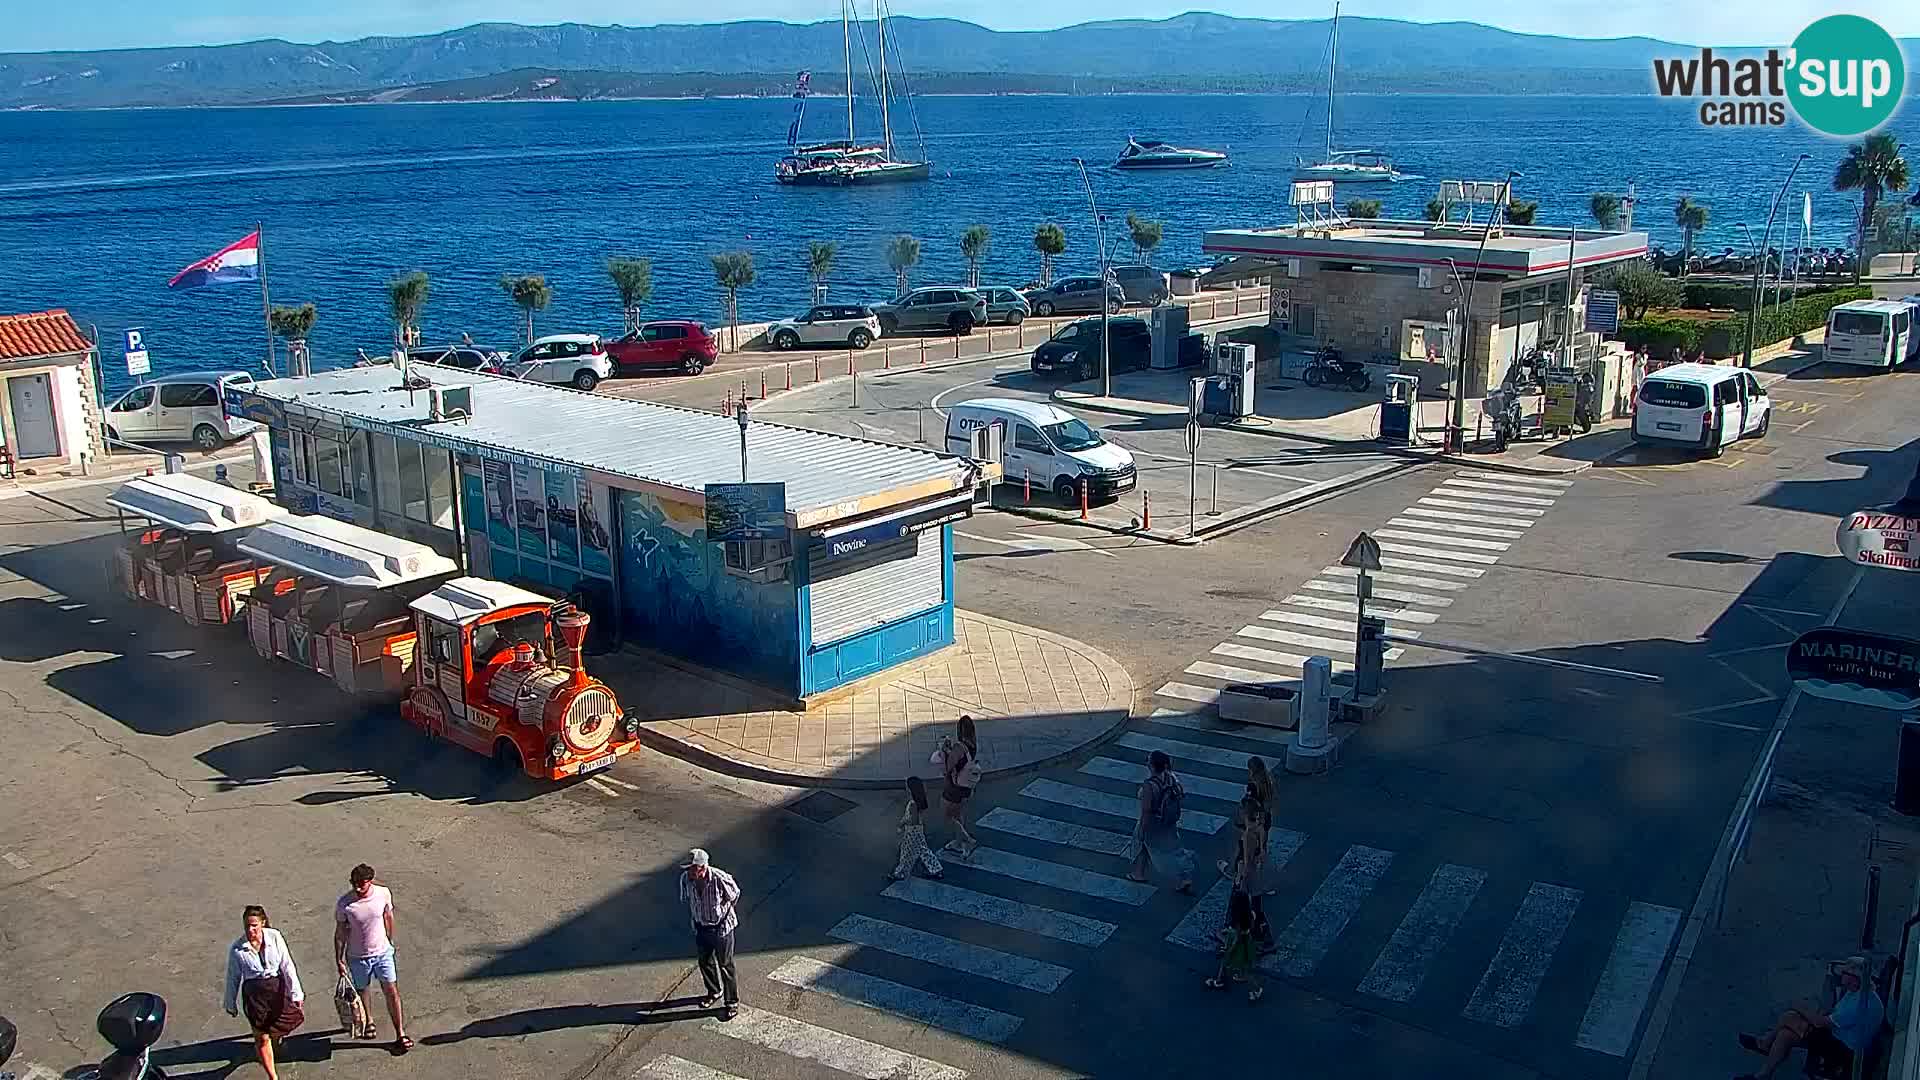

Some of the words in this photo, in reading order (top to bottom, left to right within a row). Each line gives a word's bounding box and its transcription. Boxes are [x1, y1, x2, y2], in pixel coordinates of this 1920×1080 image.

[128, 331, 141, 350] P
[433, 437, 467, 453] POSTAJA
[477, 447, 492, 458] BUS
[493, 451, 525, 465] STATION
[528, 457, 552, 472] TICKET
[554, 462, 581, 478] OFFICE
[1847, 515, 1920, 533] PIZZE
[1869, 665, 1896, 680] bar
